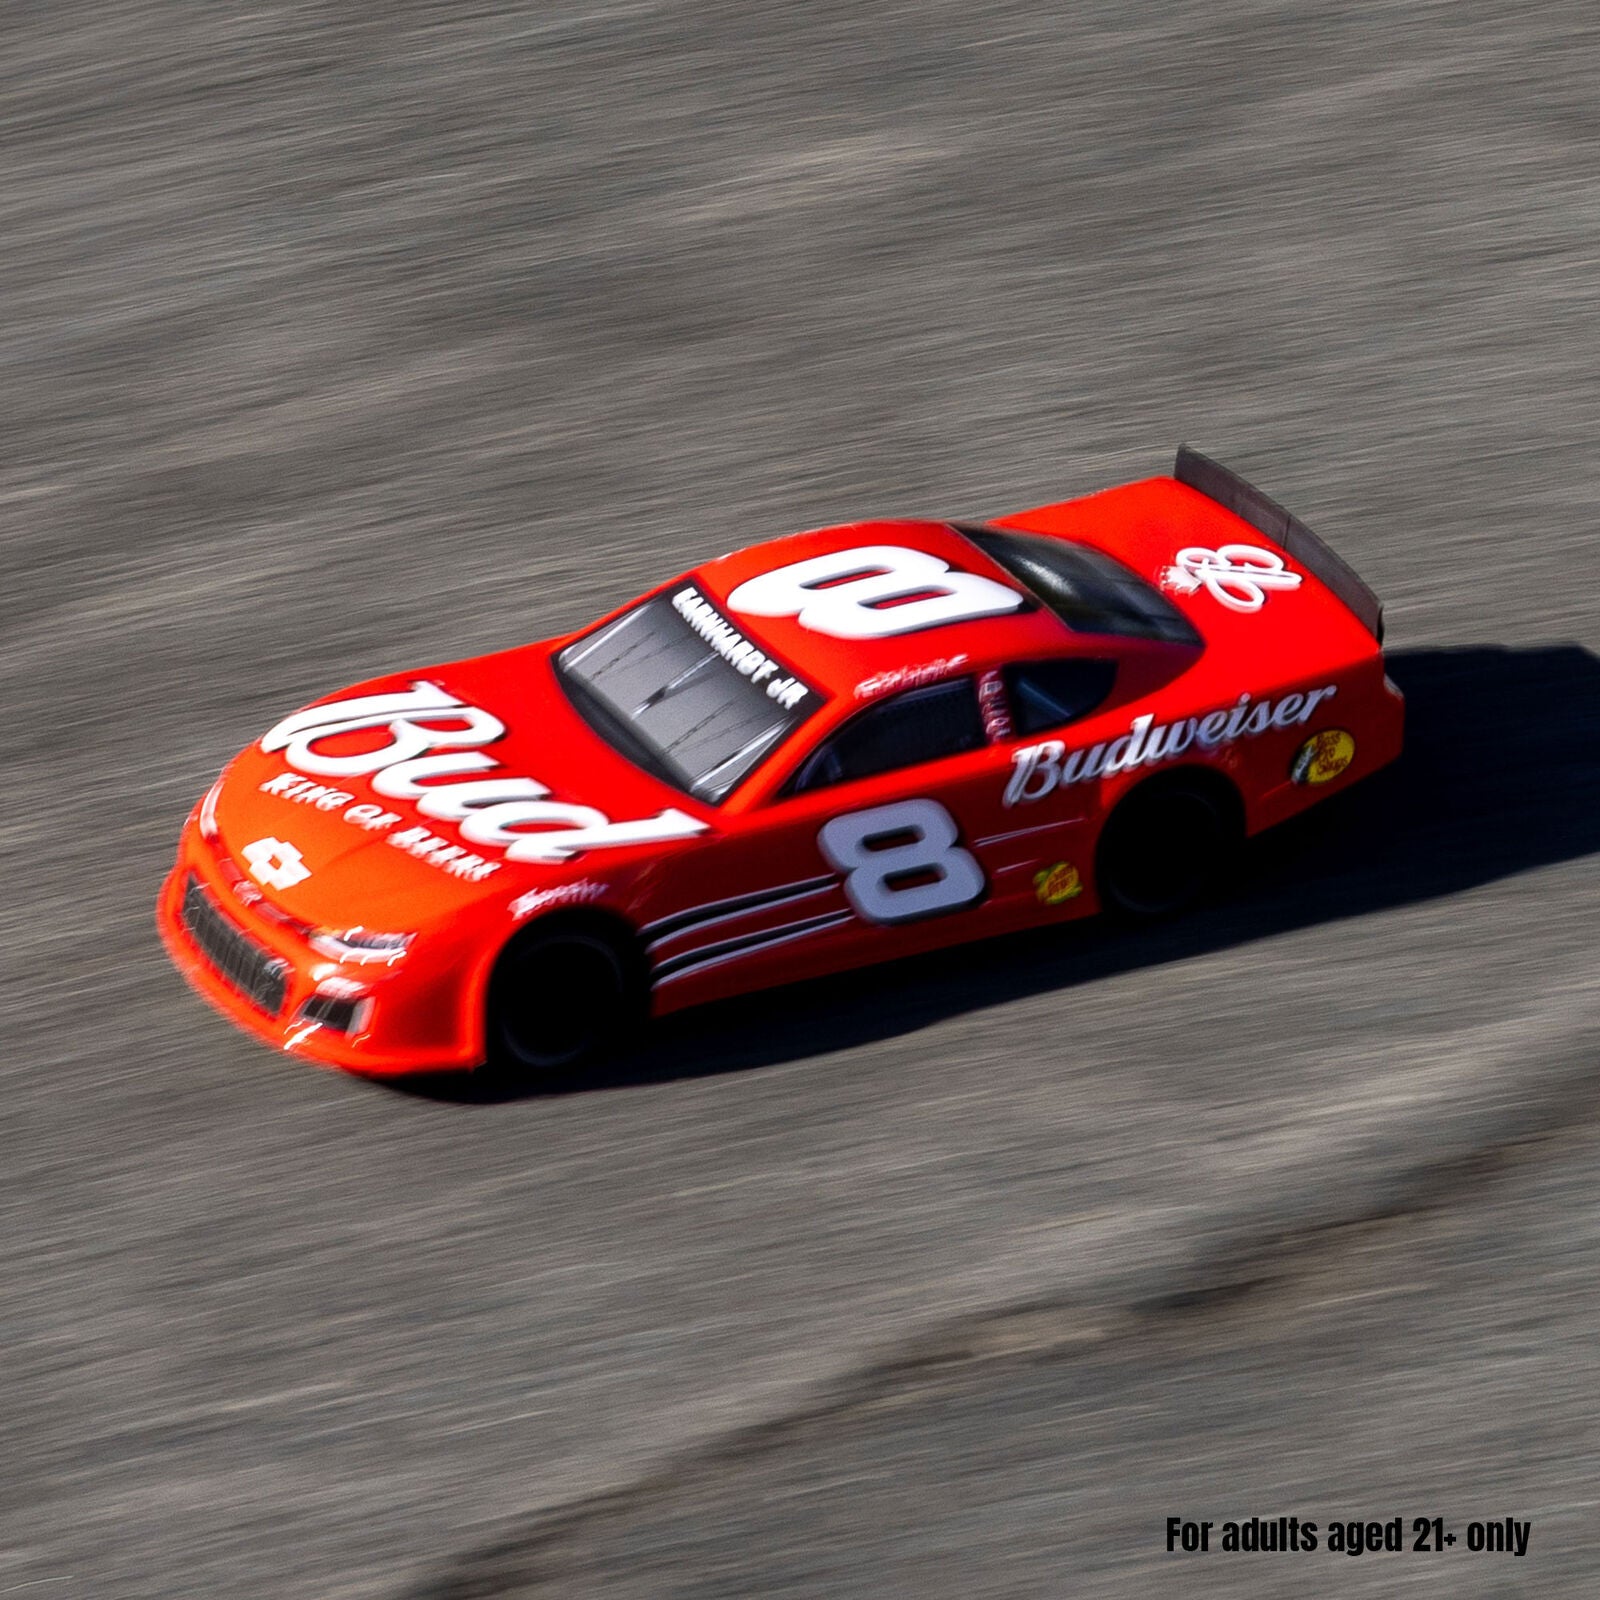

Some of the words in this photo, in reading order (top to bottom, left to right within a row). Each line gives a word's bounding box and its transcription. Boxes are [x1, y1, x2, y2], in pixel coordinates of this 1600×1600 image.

[672, 587, 779, 684] EARNHARDT
[766, 677, 809, 710] JR
[727, 545, 1023, 640] 8
[259, 772, 355, 811] KING
[343, 803, 402, 831] OF
[260, 680, 710, 864] Bud
[1003, 686, 1337, 807] Budweiser
[817, 798, 985, 920] 8
